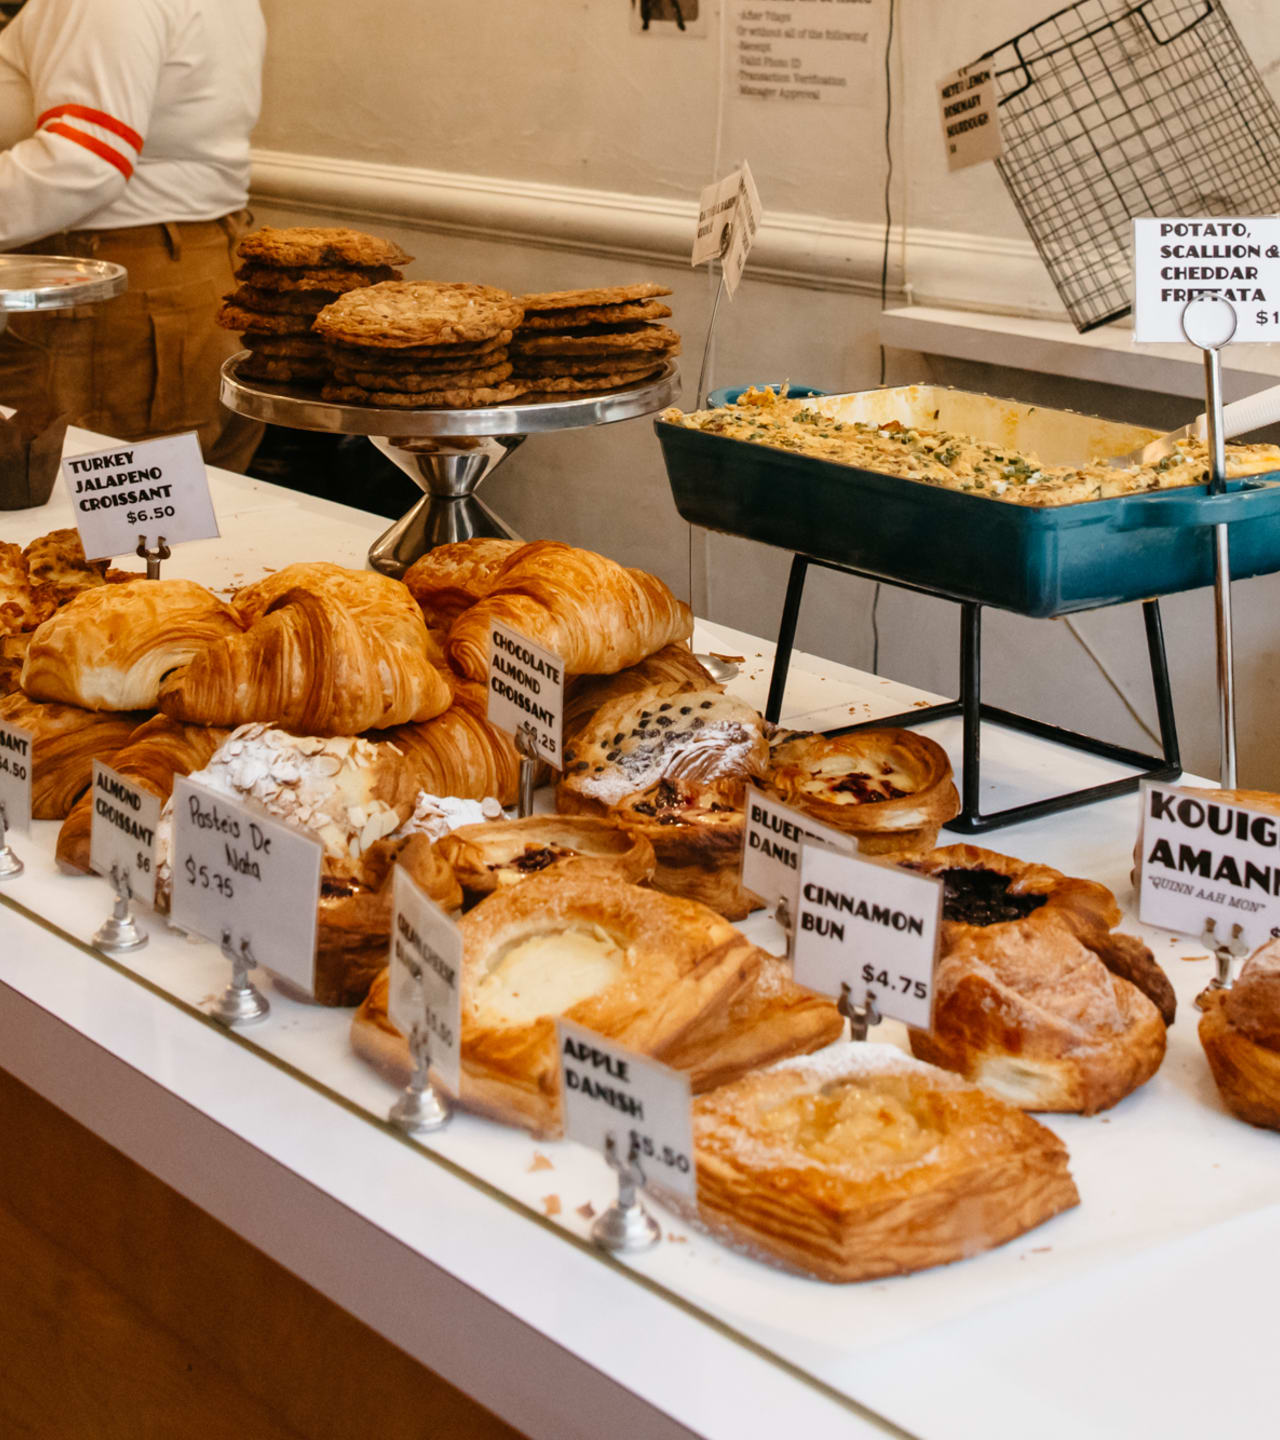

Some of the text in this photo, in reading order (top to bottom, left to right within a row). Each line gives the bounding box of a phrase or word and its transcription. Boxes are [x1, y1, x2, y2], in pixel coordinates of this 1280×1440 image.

[1160, 223, 1251, 239] POTATO,
[1160, 244, 1280, 259] SCALLION &
[1160, 266, 1258, 280] CHEDDAR
[68, 449, 135, 475] TURKEY
[74, 467, 163, 494] JALAPENO
[79, 483, 173, 513] CROISSANT
[126, 504, 176, 525] $6.50
[490, 655, 542, 696] ALMOND
[491, 631, 561, 686] CHOCOLATE
[491, 679, 556, 729] CROISSANT
[96, 771, 142, 812] ALMOND
[95, 796, 154, 847] CROISSANT
[187, 794, 272, 855] Pasteis De
[136, 851, 151, 873] $6
[749, 832, 798, 870] DANIS
[184, 860, 235, 900] $5.75
[1148, 875, 1266, 913] "QUINN AAH MON"
[801, 912, 845, 943] BUN
[802, 882, 925, 937] CINNAMON
[860, 963, 928, 1001] $4.75
[562, 1034, 629, 1083] APPLE
[564, 1069, 644, 1122] DANISH
[627, 1128, 691, 1176] $5.50
